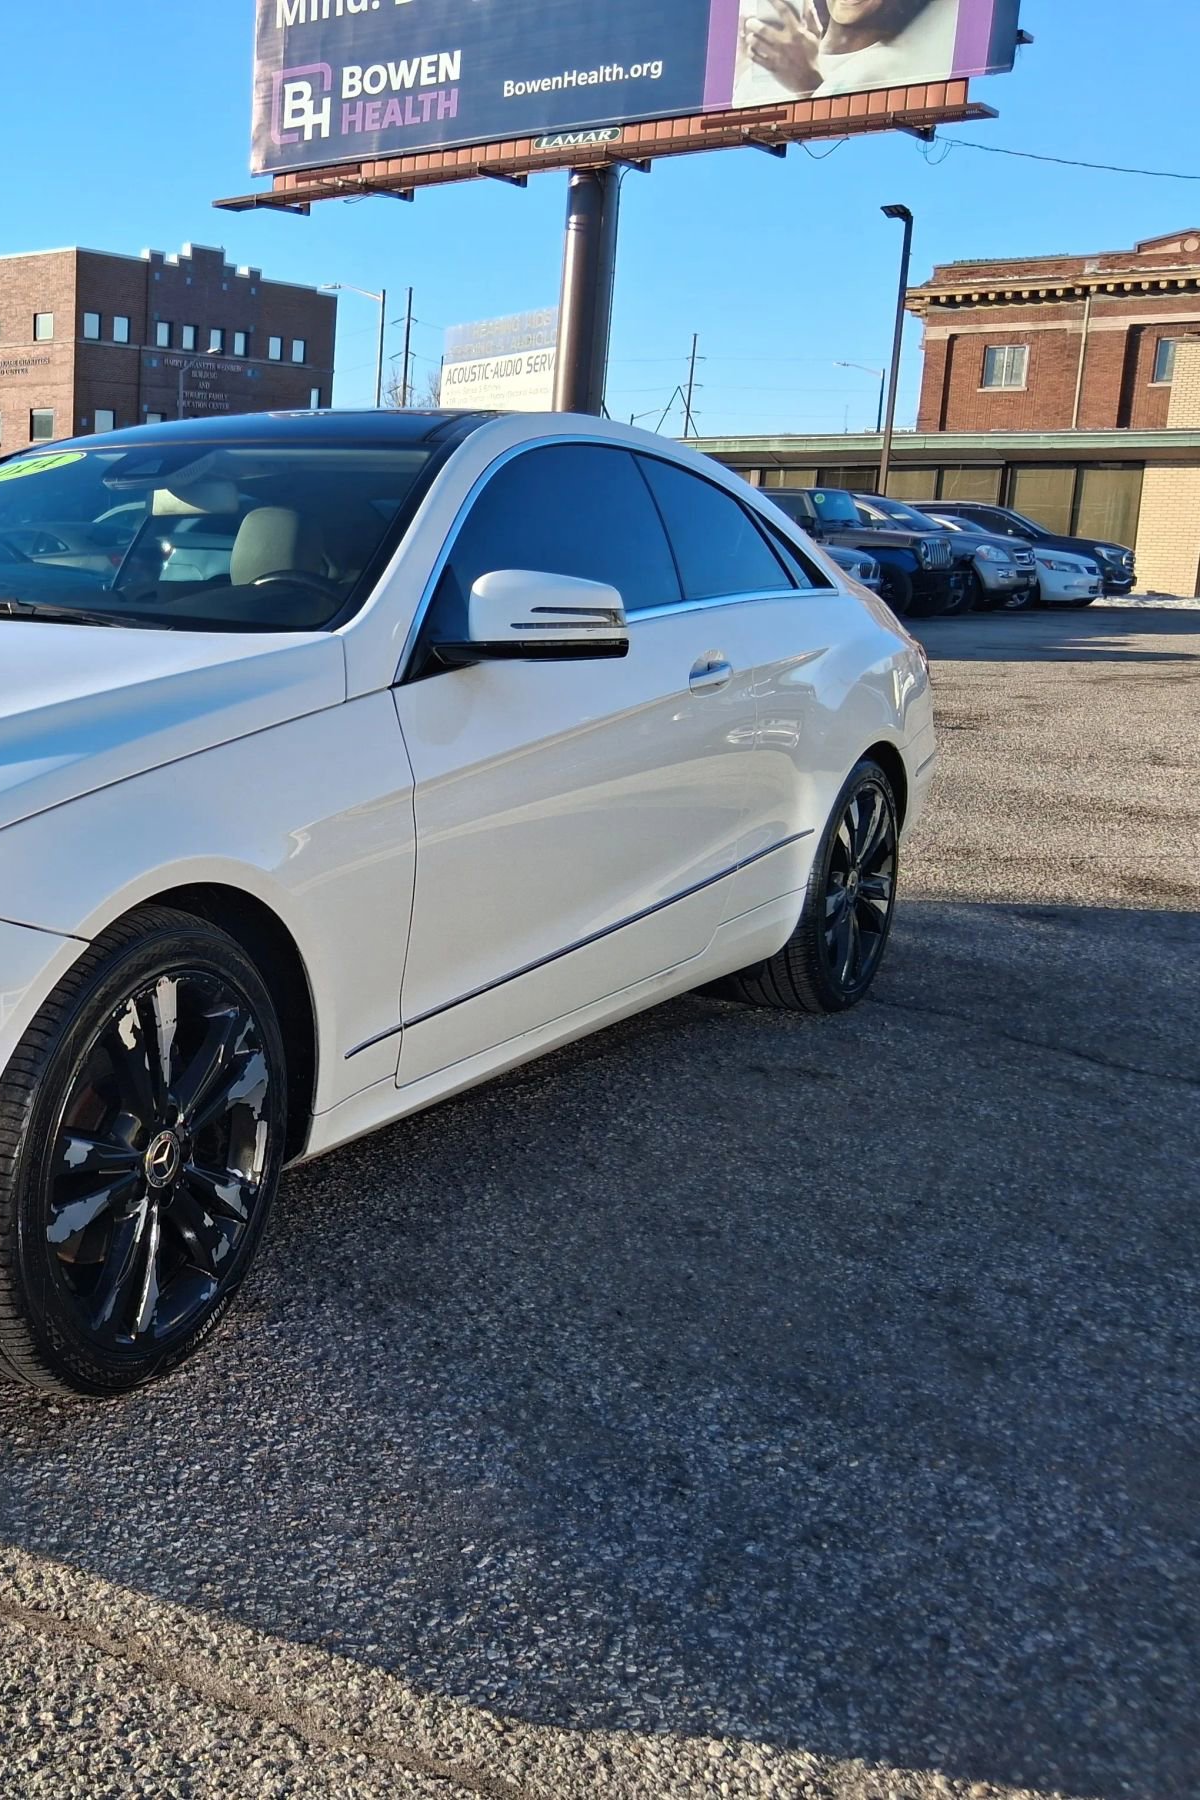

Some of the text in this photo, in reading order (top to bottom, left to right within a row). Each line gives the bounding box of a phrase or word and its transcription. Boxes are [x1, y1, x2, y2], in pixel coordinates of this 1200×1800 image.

[341, 50, 462, 99] BOWEN
[503, 60, 663, 98] BowenHealth.org
[341, 88, 459, 136] HEALTH
[540, 130, 612, 148] LAMAR
